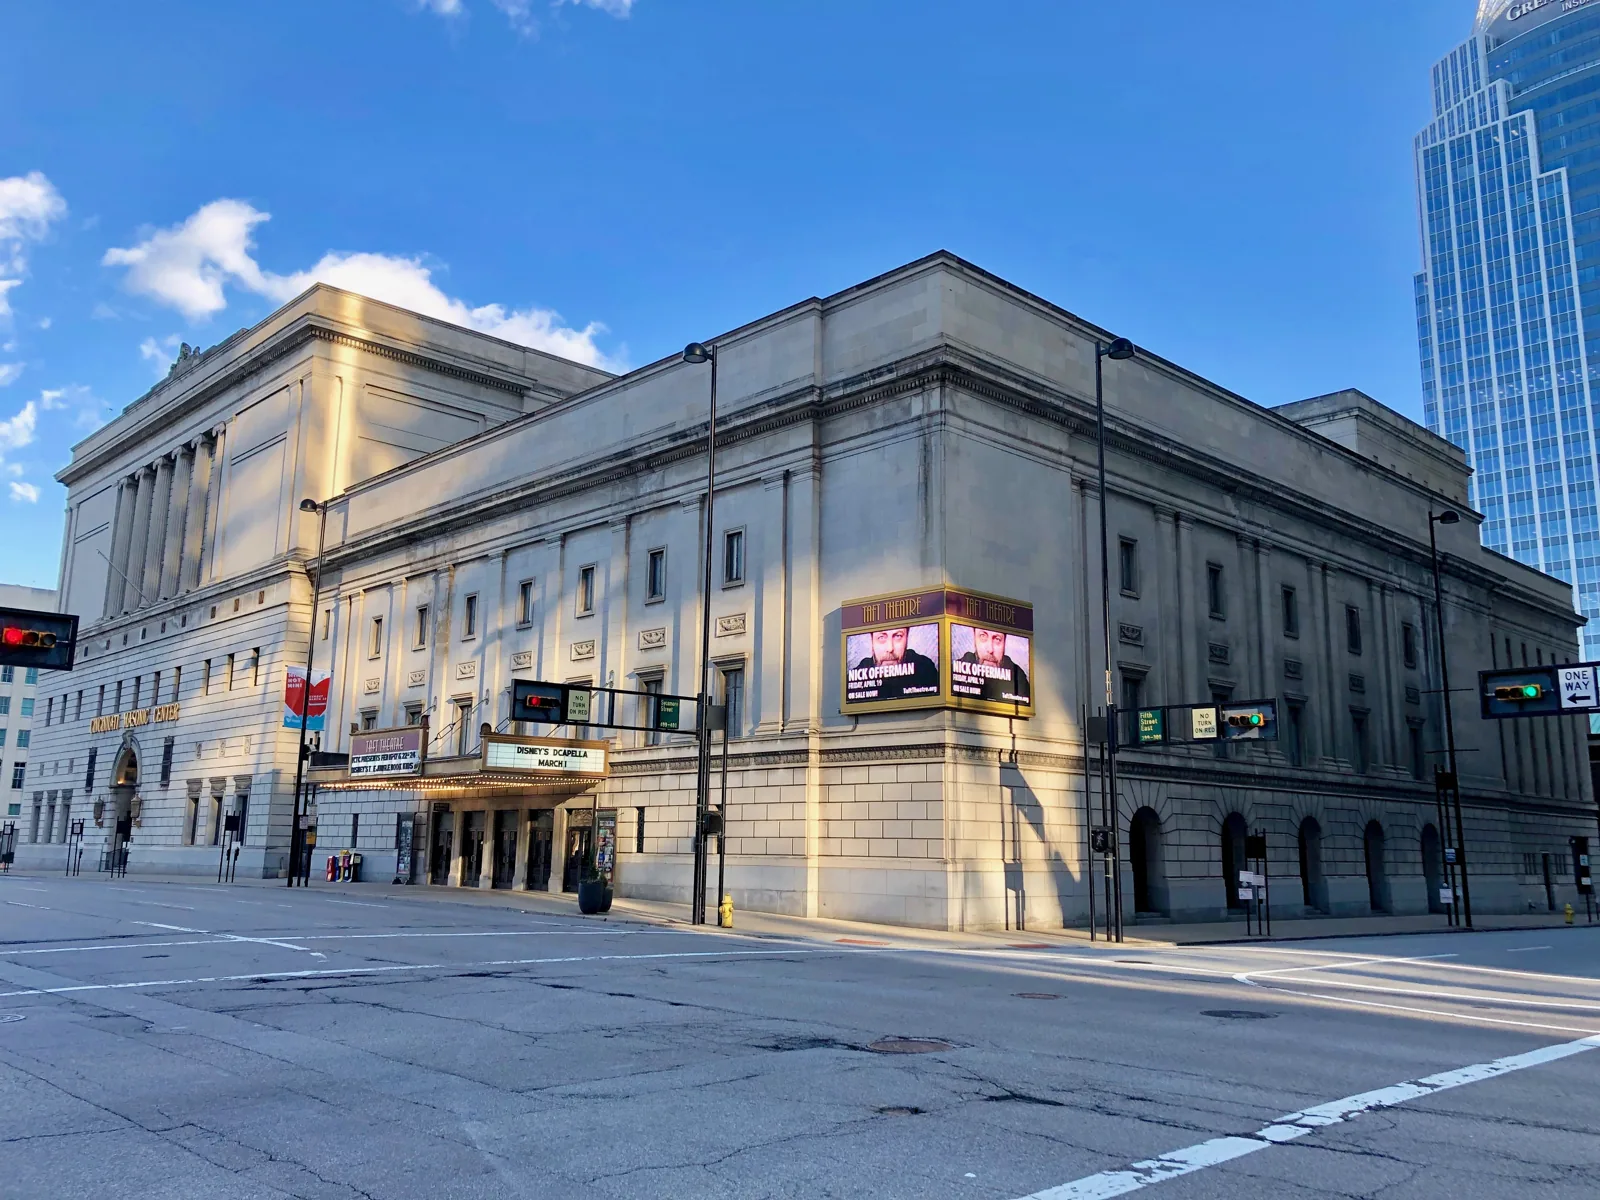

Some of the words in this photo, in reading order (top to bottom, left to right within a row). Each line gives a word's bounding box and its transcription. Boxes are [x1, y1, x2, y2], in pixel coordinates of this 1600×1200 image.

[863, 604, 881, 623] TAFT
[884, 597, 922, 620] THEATRE
[966, 597, 982, 615] TAFT
[985, 602, 1016, 625] THEATRE
[848, 668, 868, 681] NICK
[868, 662, 914, 679] OFFERMAN
[953, 660, 971, 675] NICK
[971, 663, 1011, 681] OFFERMAN
[1565, 671, 1589, 680] ONE
[864, 680, 876, 688] APRIL
[1565, 681, 1589, 691] WAY
[153, 703, 180, 723] CENTER
[366, 740, 378, 753] TAFT
[379, 737, 404, 751] THEATRE
[517, 746, 549, 755] DISNEY'S
[553, 749, 588, 758] DCAPELLA
[538, 759, 563, 768] MARCH
